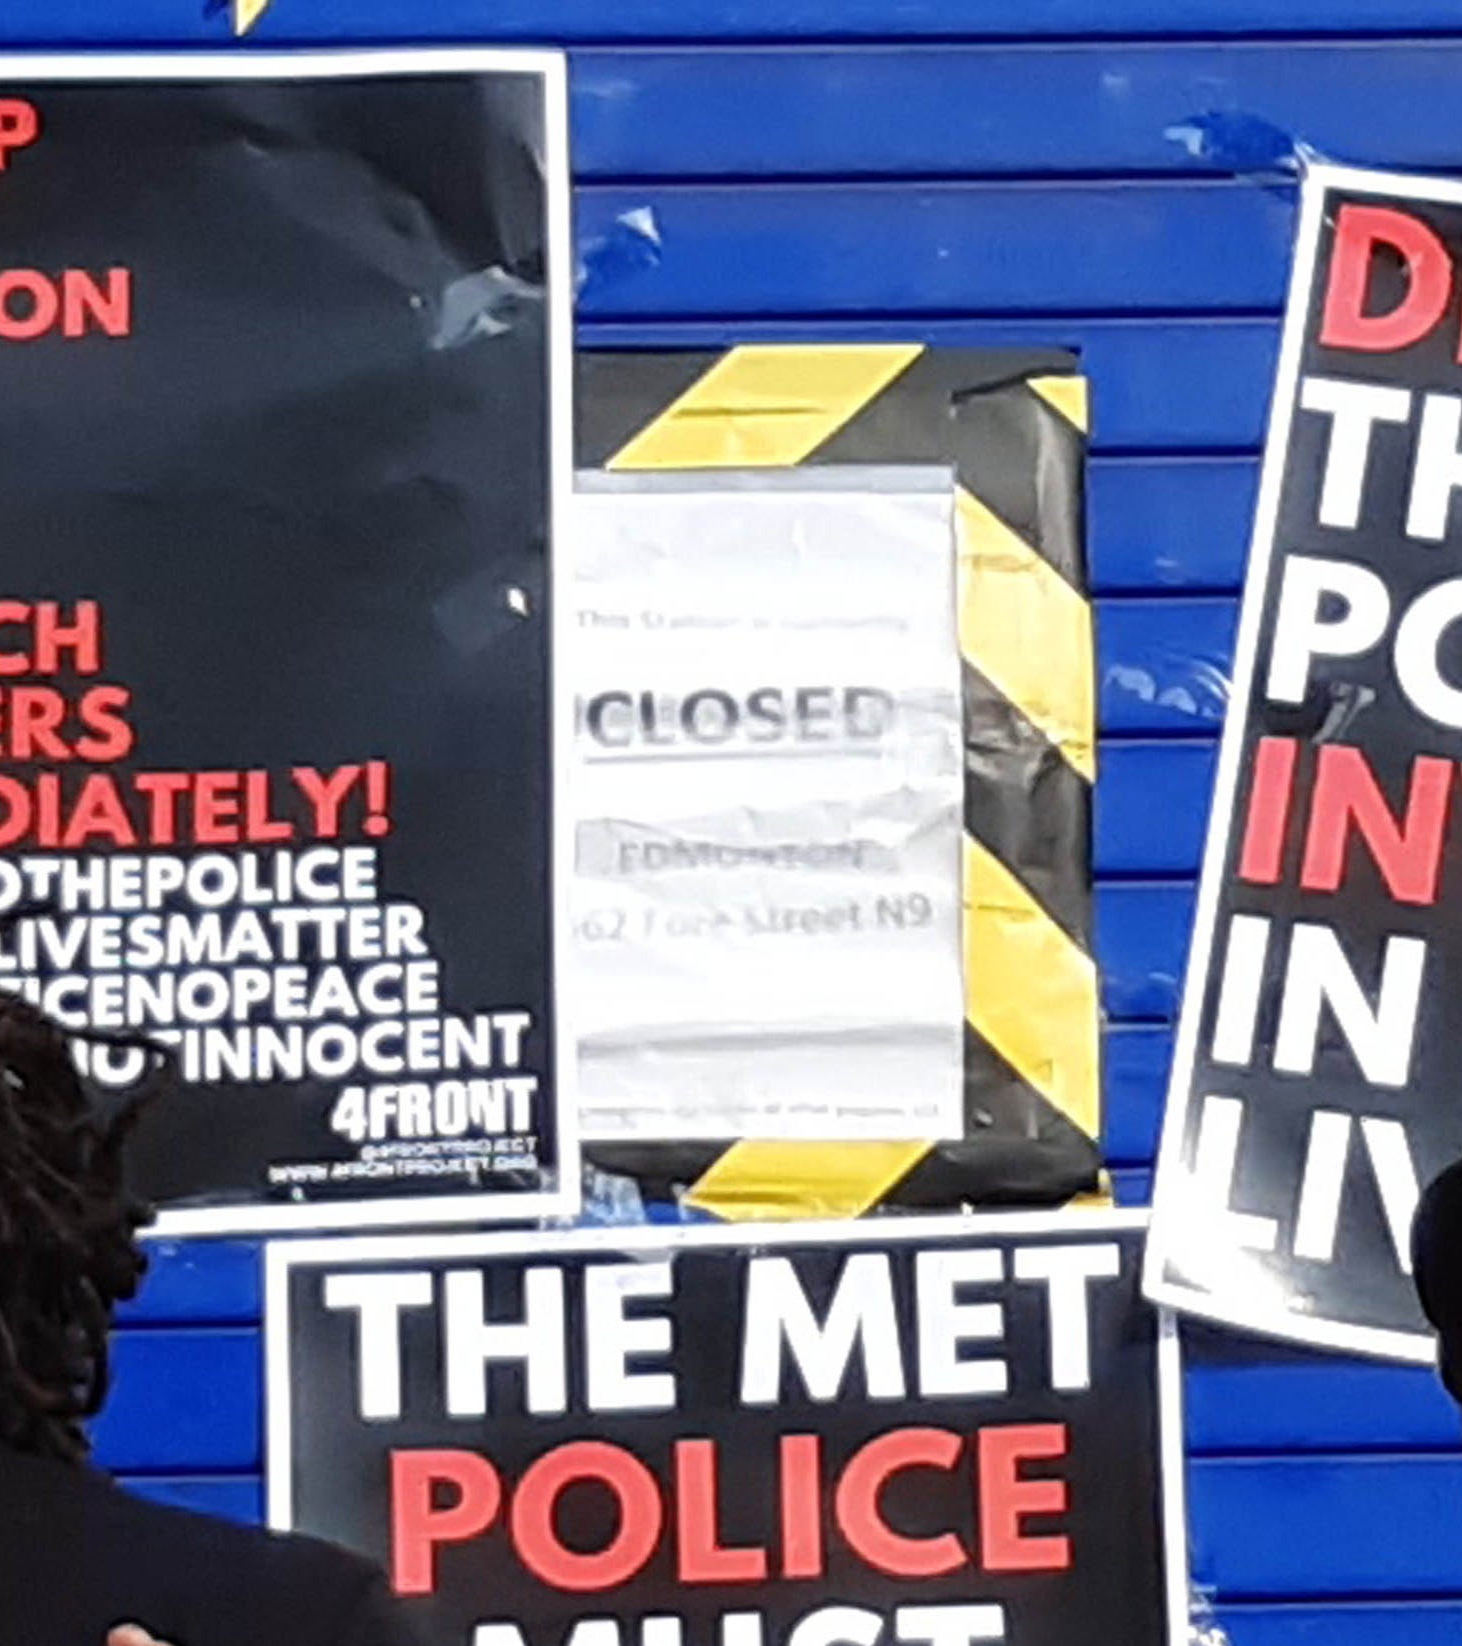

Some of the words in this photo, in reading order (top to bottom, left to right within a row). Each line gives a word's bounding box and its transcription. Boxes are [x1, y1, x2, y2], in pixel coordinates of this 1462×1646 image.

[585, 686, 895, 749] CLOSED
[572, 906, 627, 942] 62
[745, 901, 863, 934] Street
[875, 892, 933, 929] N9
[1212, 912, 1429, 1090] IN
[331, 1077, 538, 1142] 4FRONT
[1192, 1092, 1421, 1276] LIV
[325, 1250, 679, 1418] THE
[742, 1243, 1120, 1404] MET
[389, 1424, 1074, 1598] POLICE
